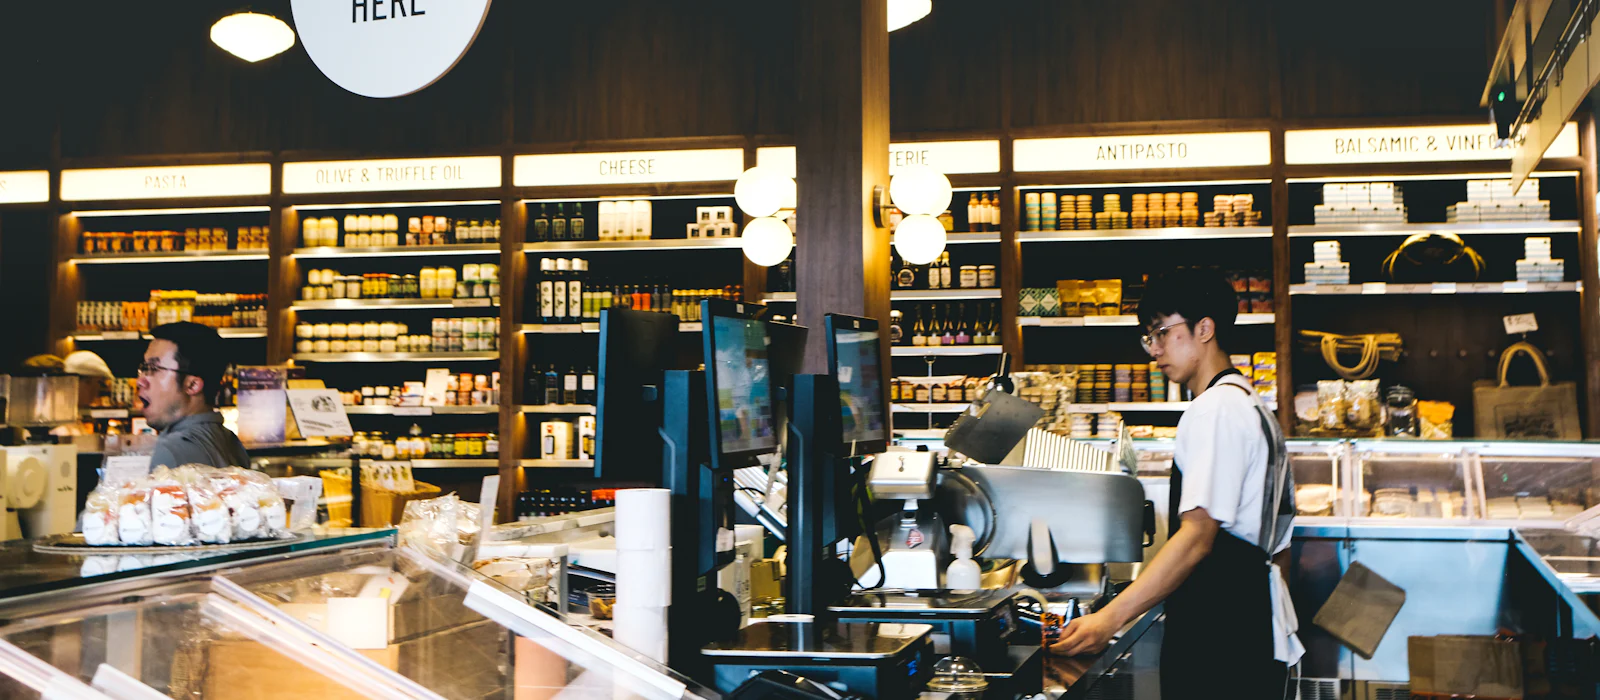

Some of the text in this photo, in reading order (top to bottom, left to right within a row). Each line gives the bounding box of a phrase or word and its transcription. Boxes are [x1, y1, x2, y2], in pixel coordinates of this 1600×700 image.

[1096, 142, 1188, 160] ANTIPASTO
[1335, 136, 1419, 154] BALSAMIC
[1427, 136, 1438, 151] &
[315, 165, 464, 184] OLIVE & TRUFFLE OIL
[599, 159, 656, 176] CHEESE
[144, 175, 187, 189] PASTA
